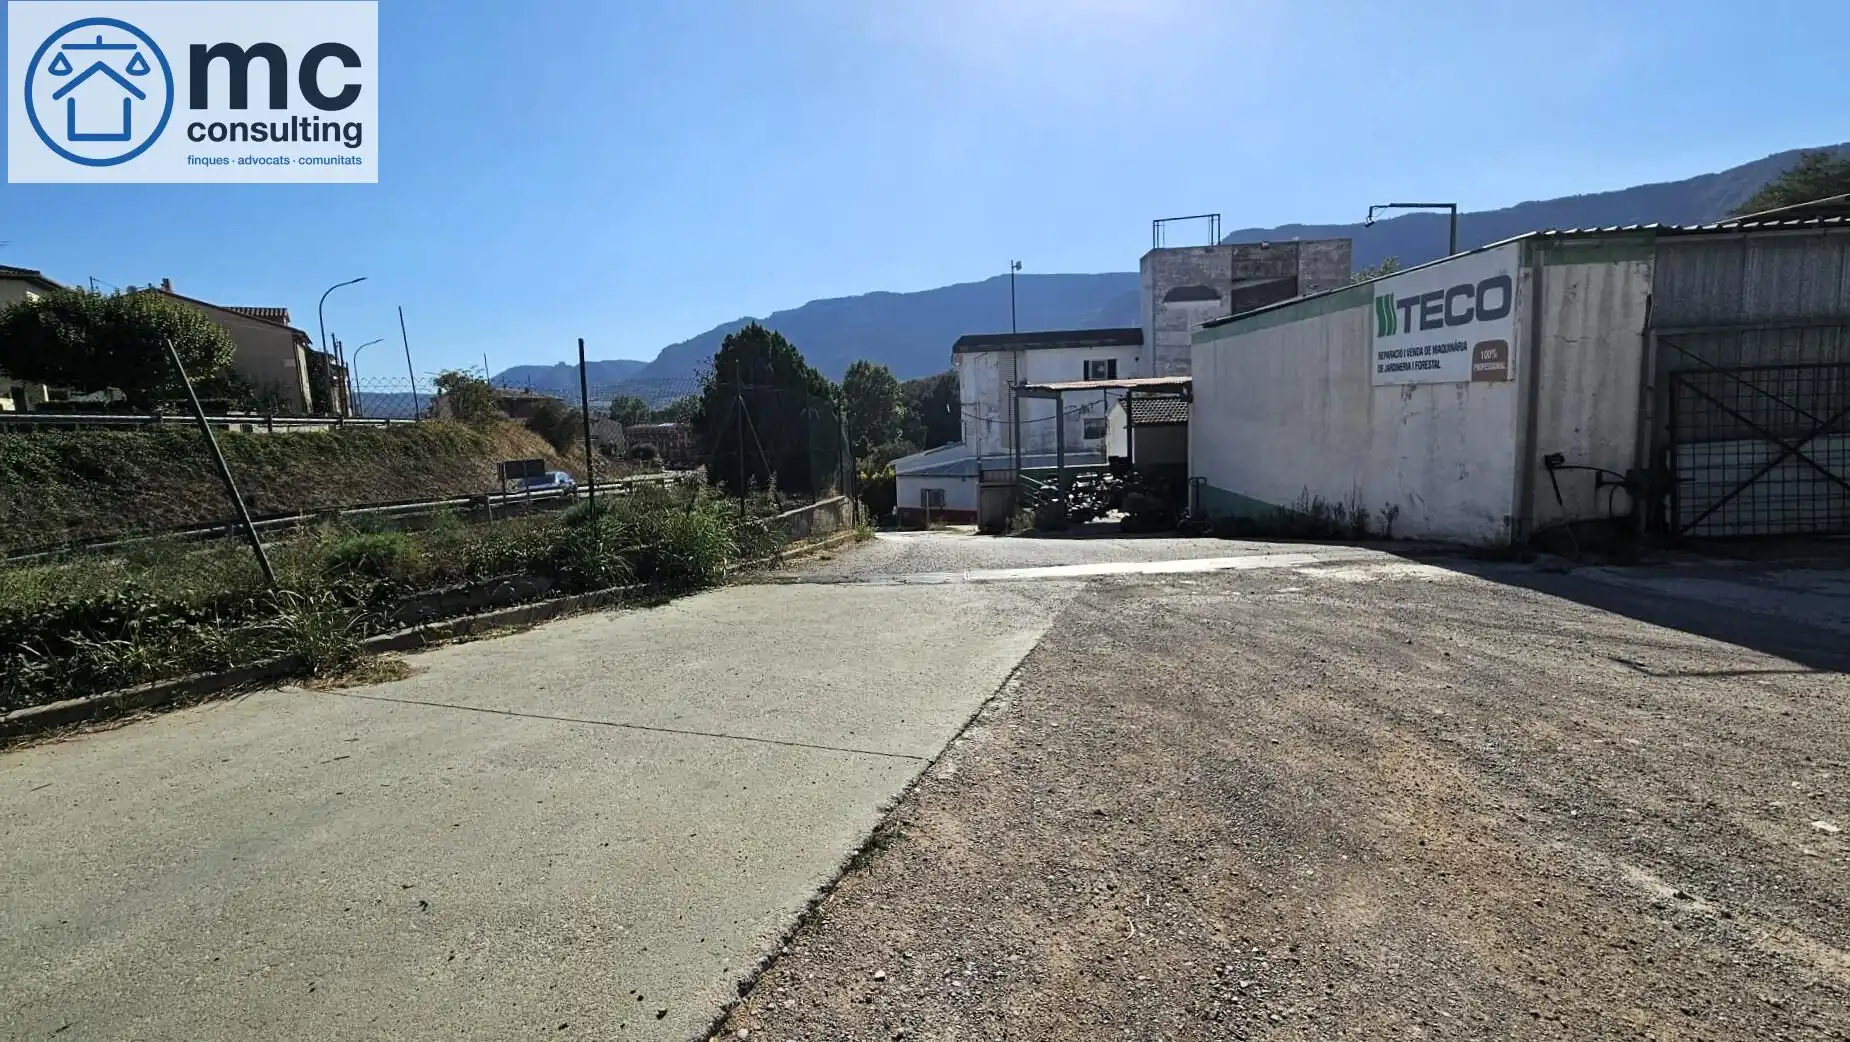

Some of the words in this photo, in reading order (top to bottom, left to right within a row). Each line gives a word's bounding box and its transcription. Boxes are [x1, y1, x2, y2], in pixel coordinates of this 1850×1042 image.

[1396, 275, 1512, 334] TECO
[1424, 345, 1431, 355] DE
[1480, 348, 1498, 360] 100%
